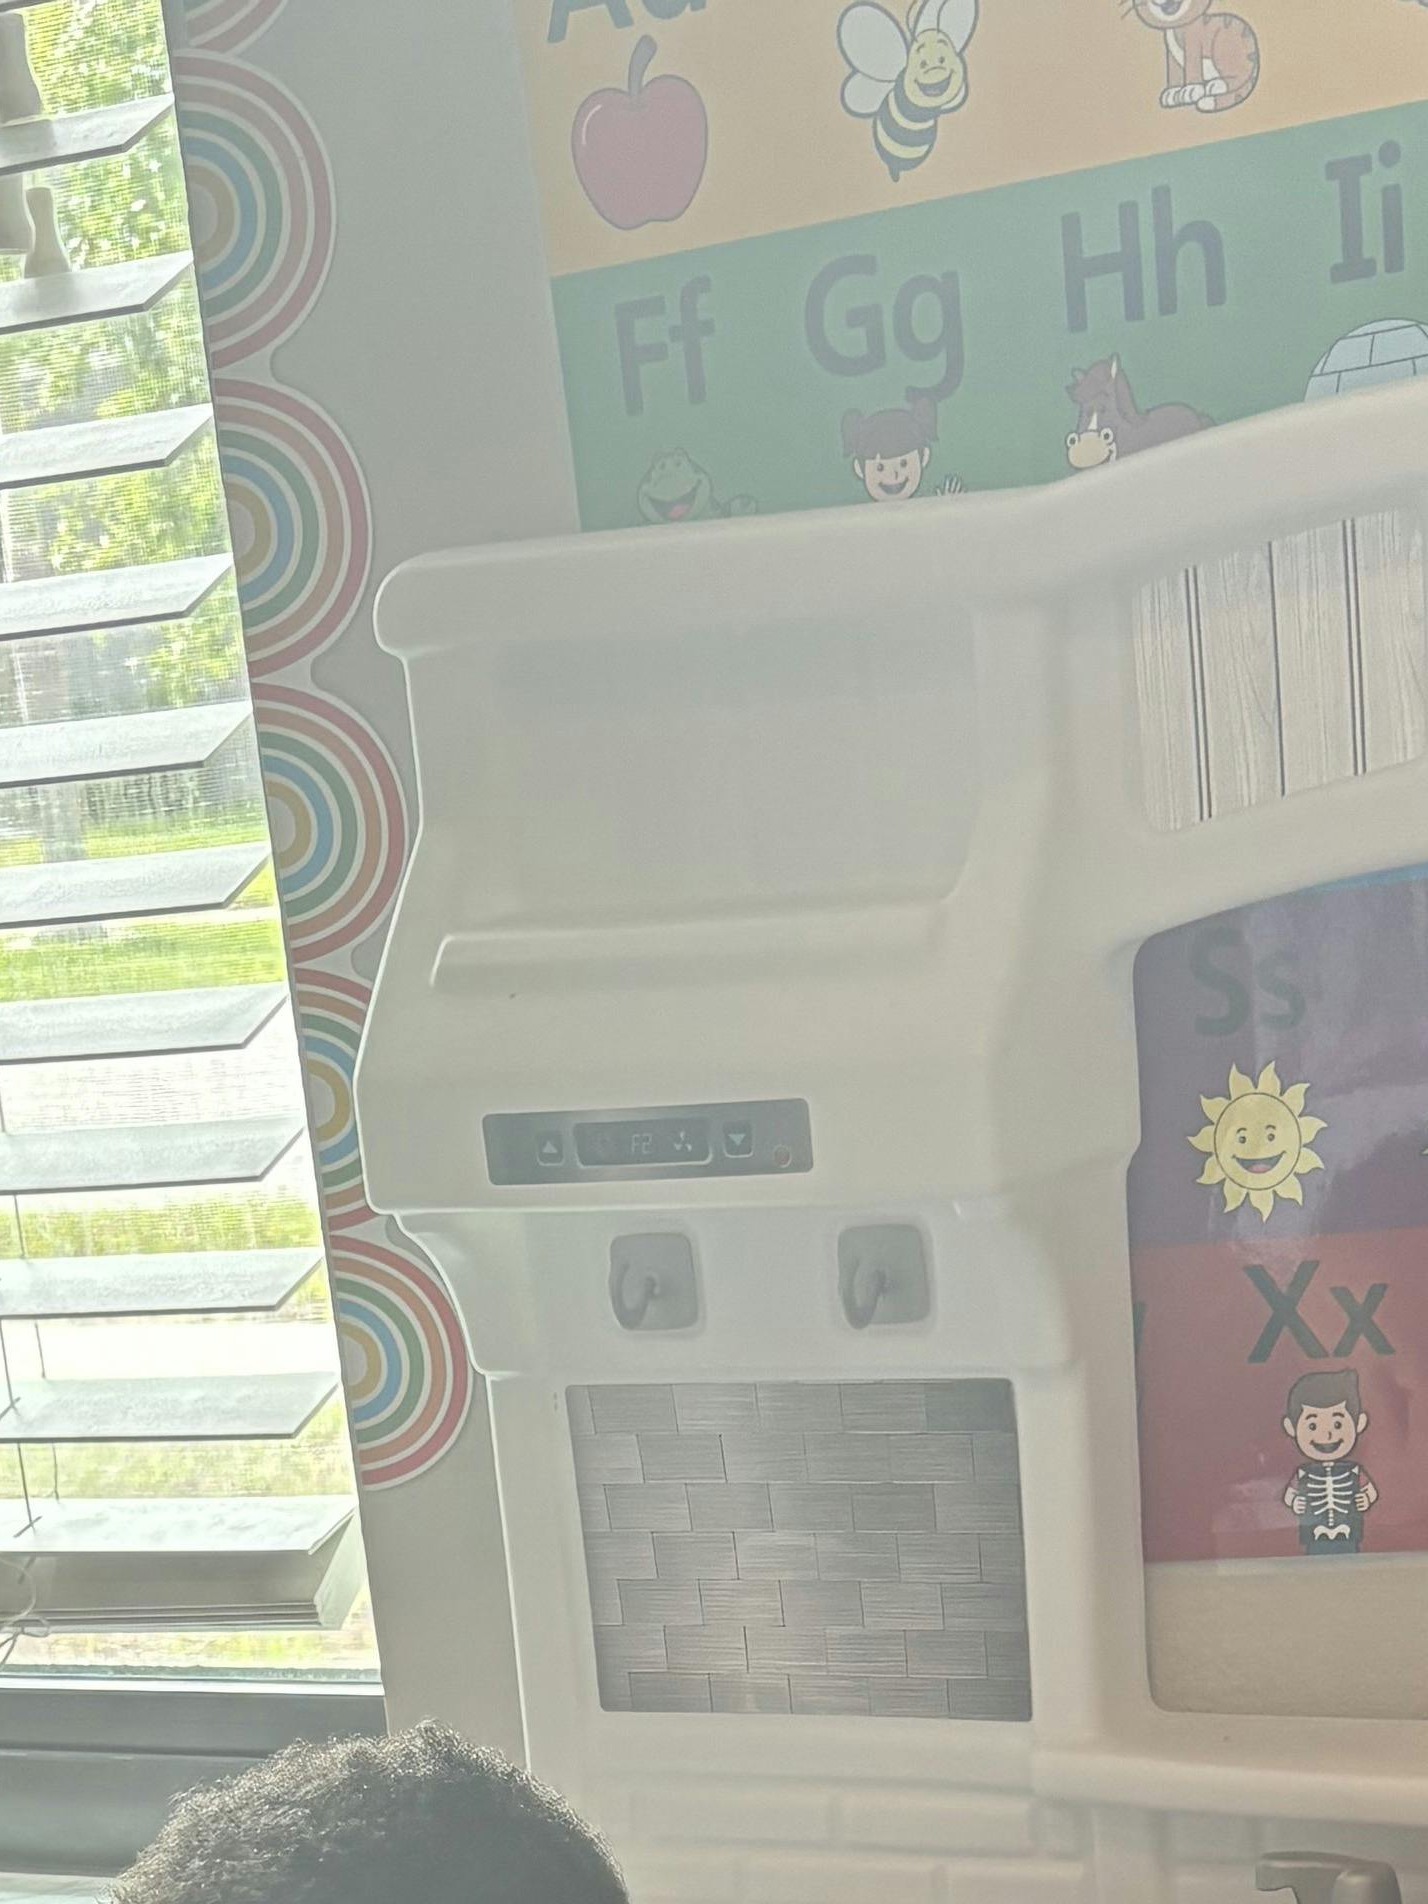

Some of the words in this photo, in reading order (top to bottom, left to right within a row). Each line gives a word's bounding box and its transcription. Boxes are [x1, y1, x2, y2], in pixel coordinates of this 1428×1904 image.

[615, 276, 717, 416] Ff
[804, 256, 964, 401] Gg
[1061, 186, 1228, 333] Hh
[1325, 144, 1404, 284] Ii
[1190, 929, 1305, 1036] Ss
[1245, 1259, 1395, 1364] Xx
